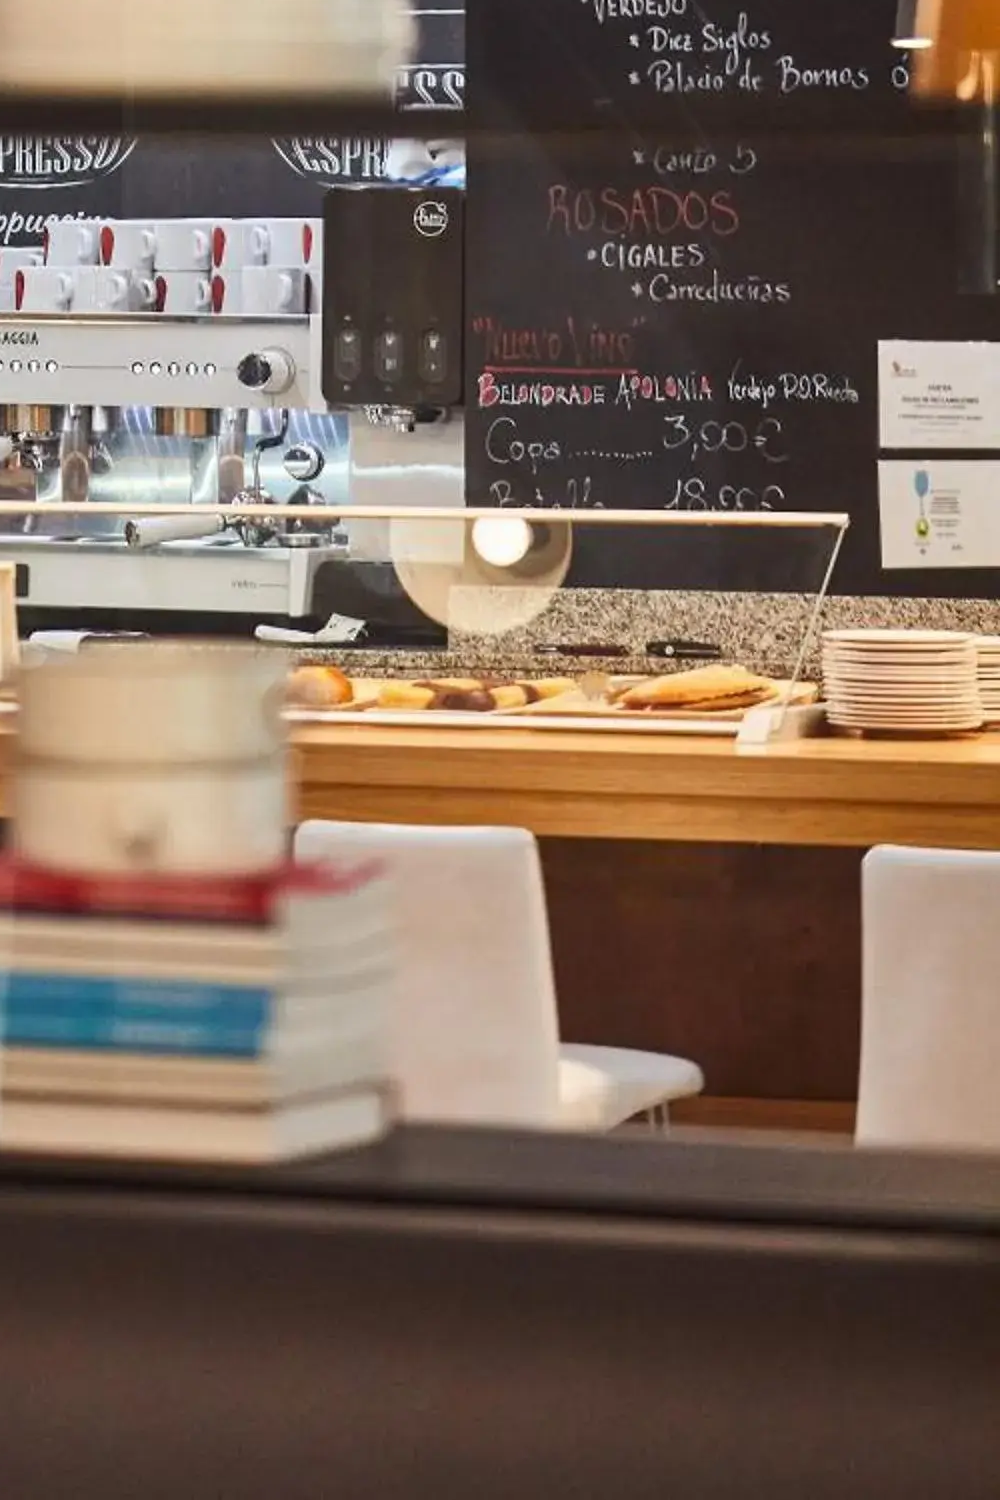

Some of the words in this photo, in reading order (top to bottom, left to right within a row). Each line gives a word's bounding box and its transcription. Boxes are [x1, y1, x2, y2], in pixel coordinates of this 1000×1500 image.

[647, 25, 693, 52] Diez
[702, 11, 772, 75] Siglos
[775, 54, 870, 93] Bornos
[546, 184, 740, 236] ROSADOS
[478, 372, 606, 408] BELONDRADE
[485, 417, 560, 475] Copa
